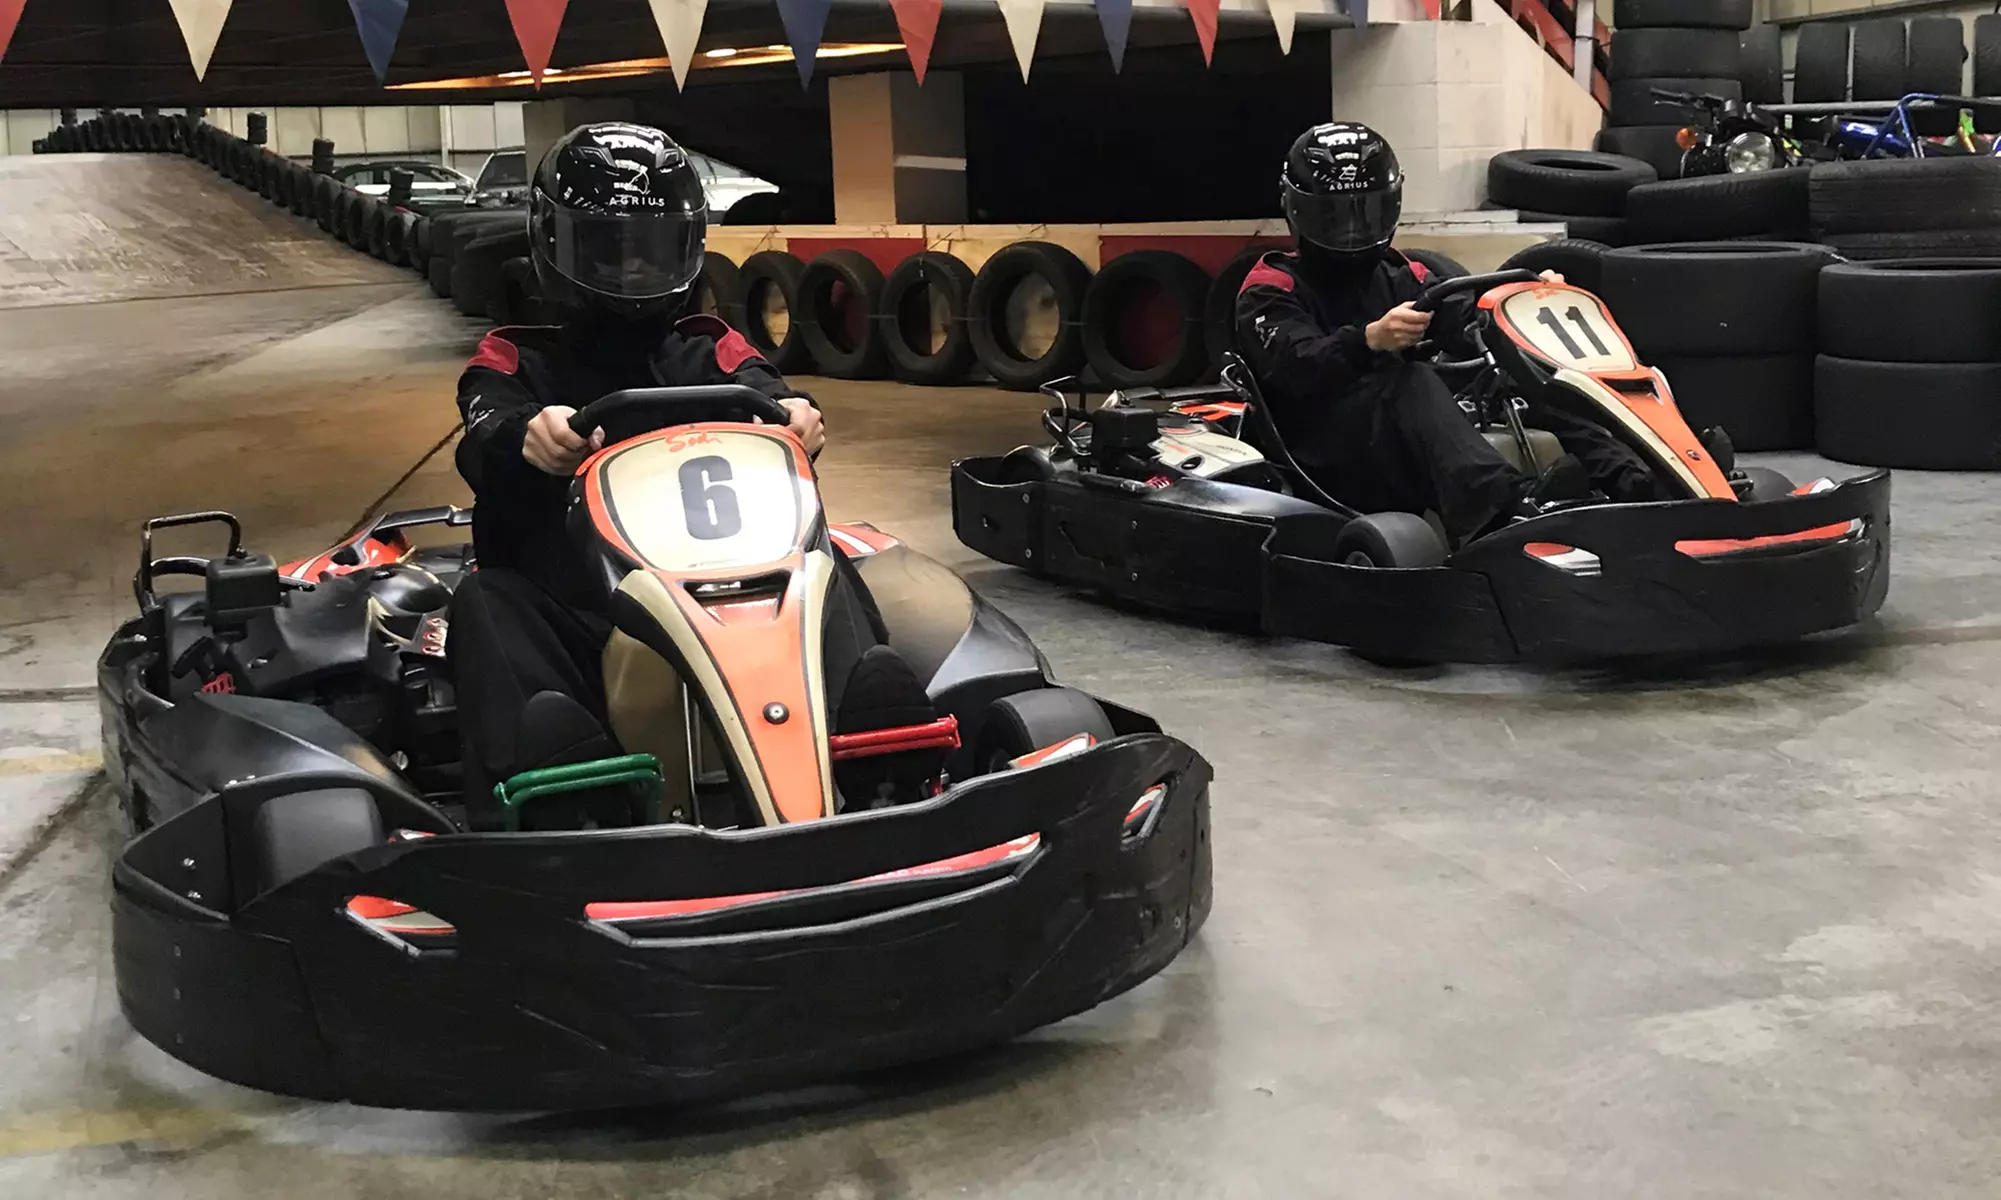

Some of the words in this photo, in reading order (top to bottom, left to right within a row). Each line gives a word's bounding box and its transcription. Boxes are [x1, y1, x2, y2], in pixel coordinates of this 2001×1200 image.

[609, 196, 665, 207] AGRIUS
[1536, 306, 1611, 360] 11
[678, 455, 742, 540] 6
